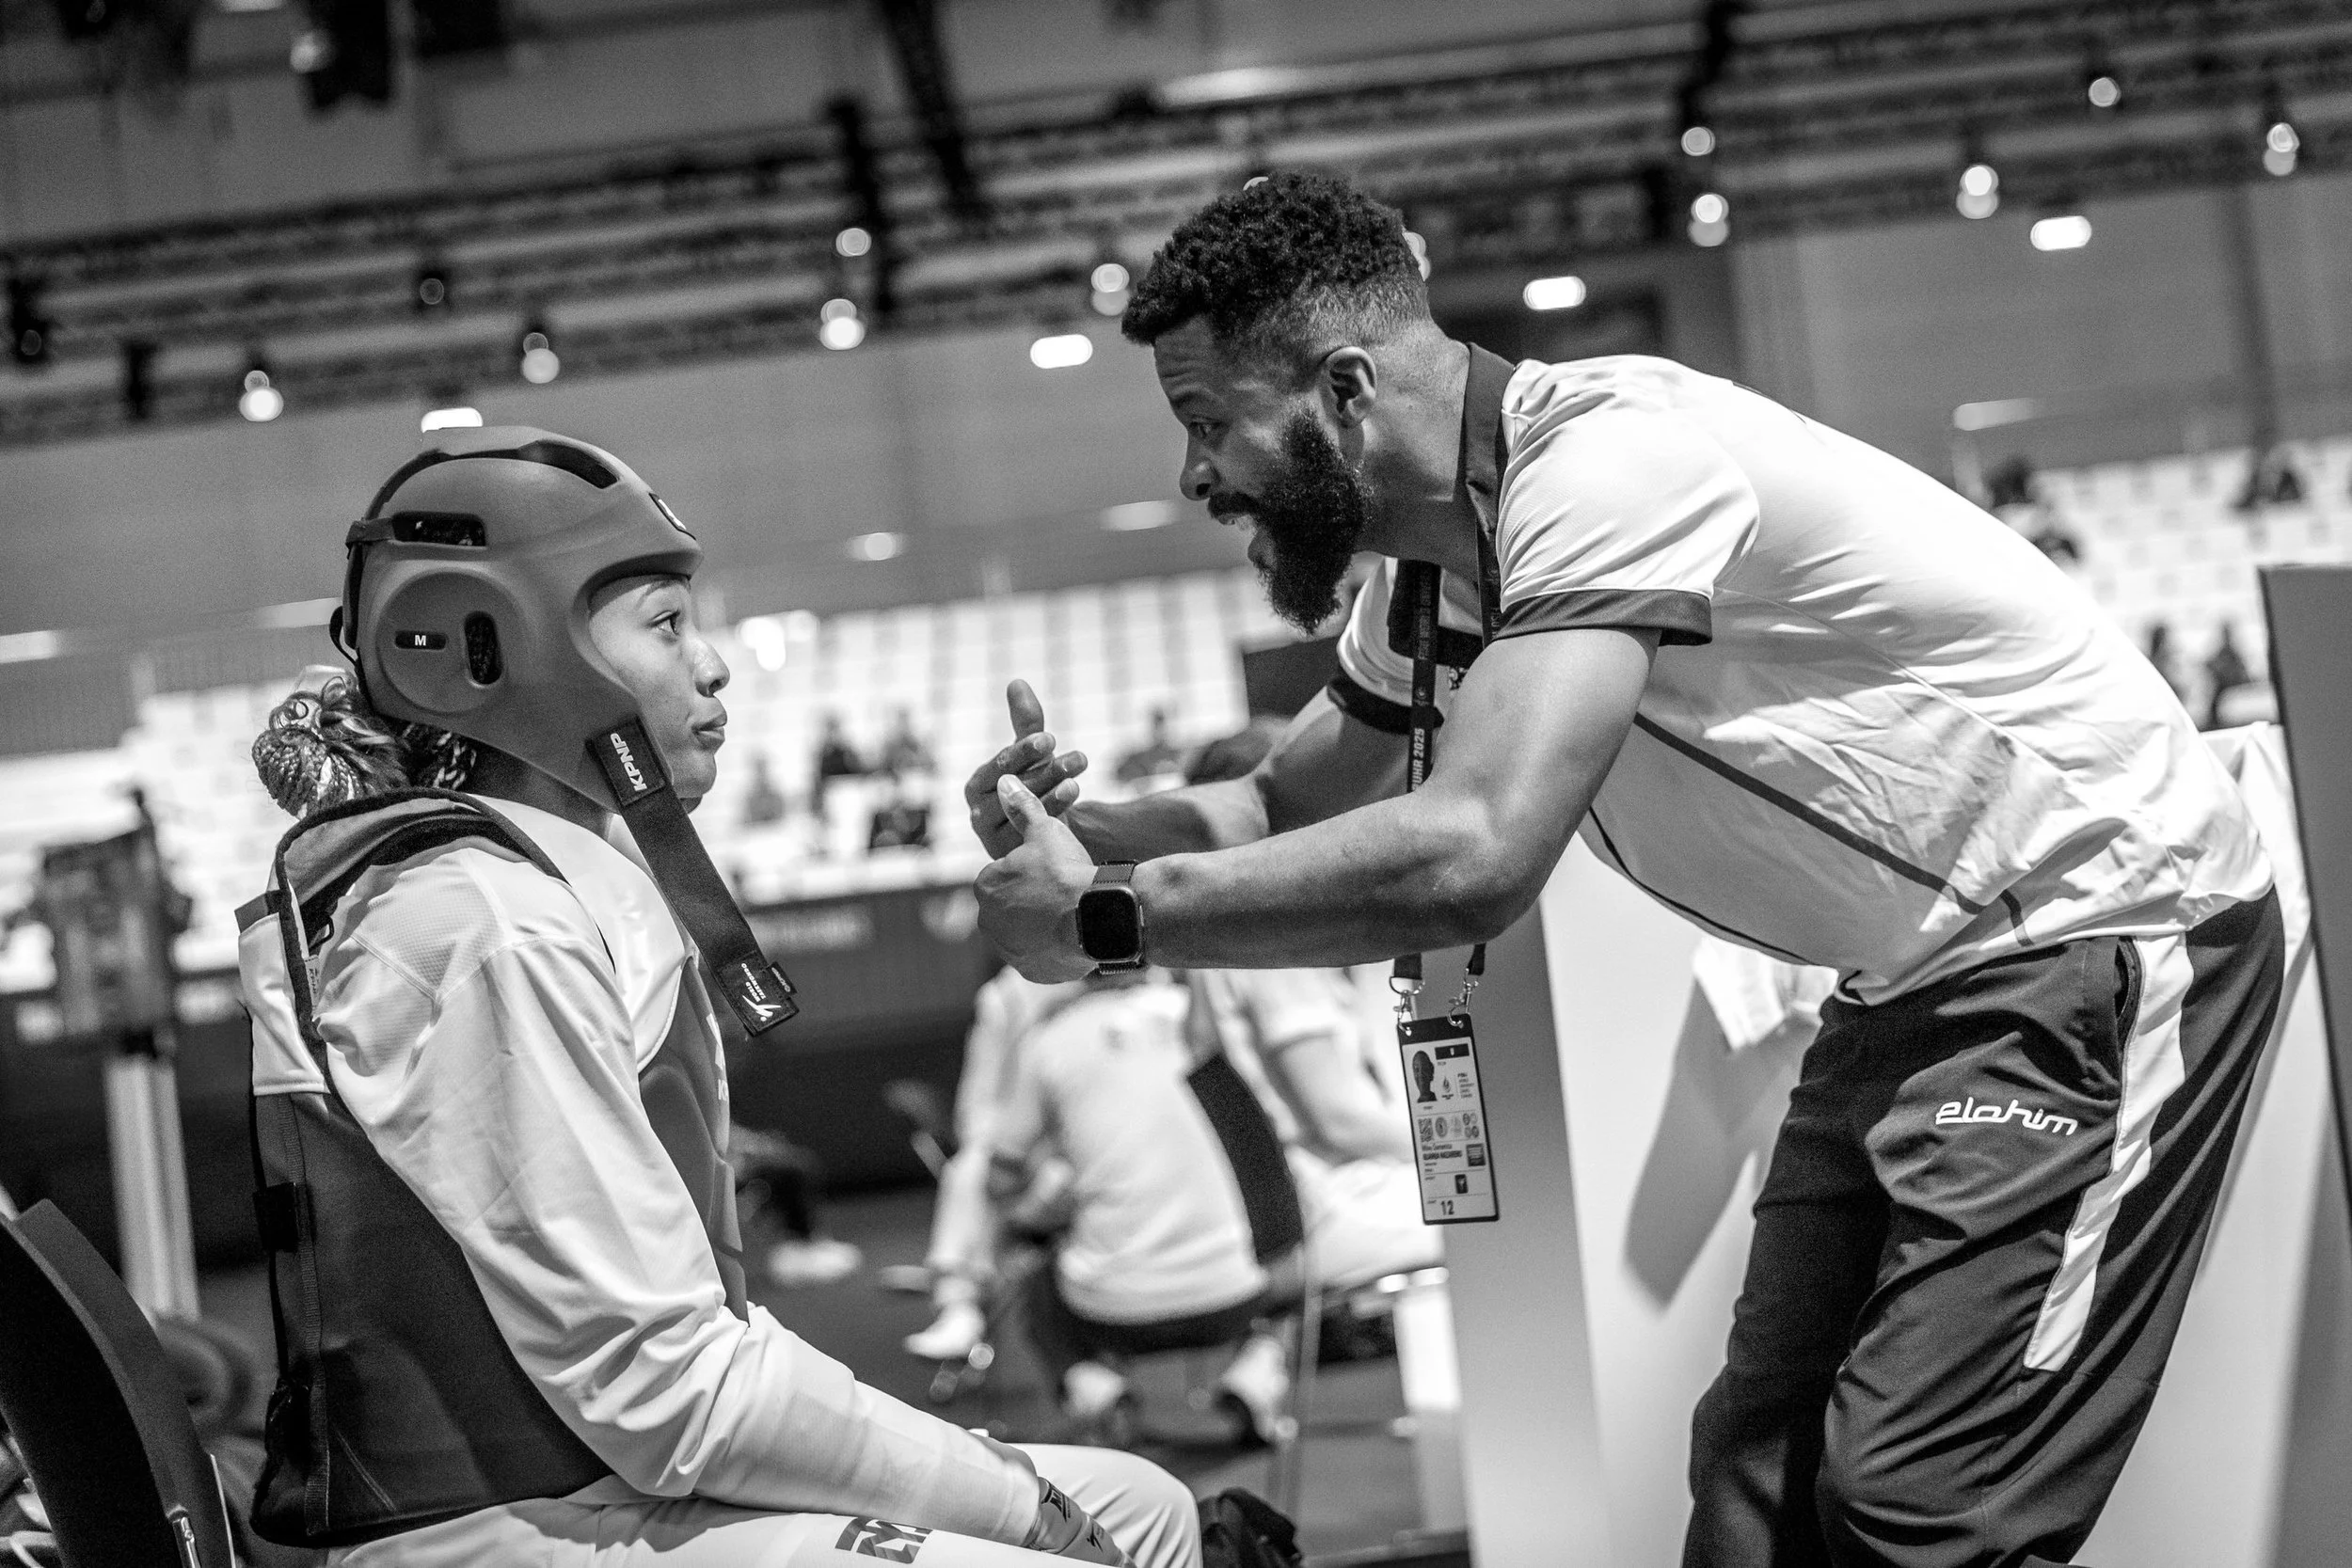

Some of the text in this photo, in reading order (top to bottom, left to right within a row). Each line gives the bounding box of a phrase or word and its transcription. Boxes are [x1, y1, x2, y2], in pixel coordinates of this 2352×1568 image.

[415, 634, 427, 646] M
[1413, 727, 1425, 758] 2025
[610, 733, 647, 791] KPNP
[741, 962, 767, 1000] TAEKWONDO
[745, 981, 761, 1003] WORLD
[1440, 1199, 1455, 1215] 12
